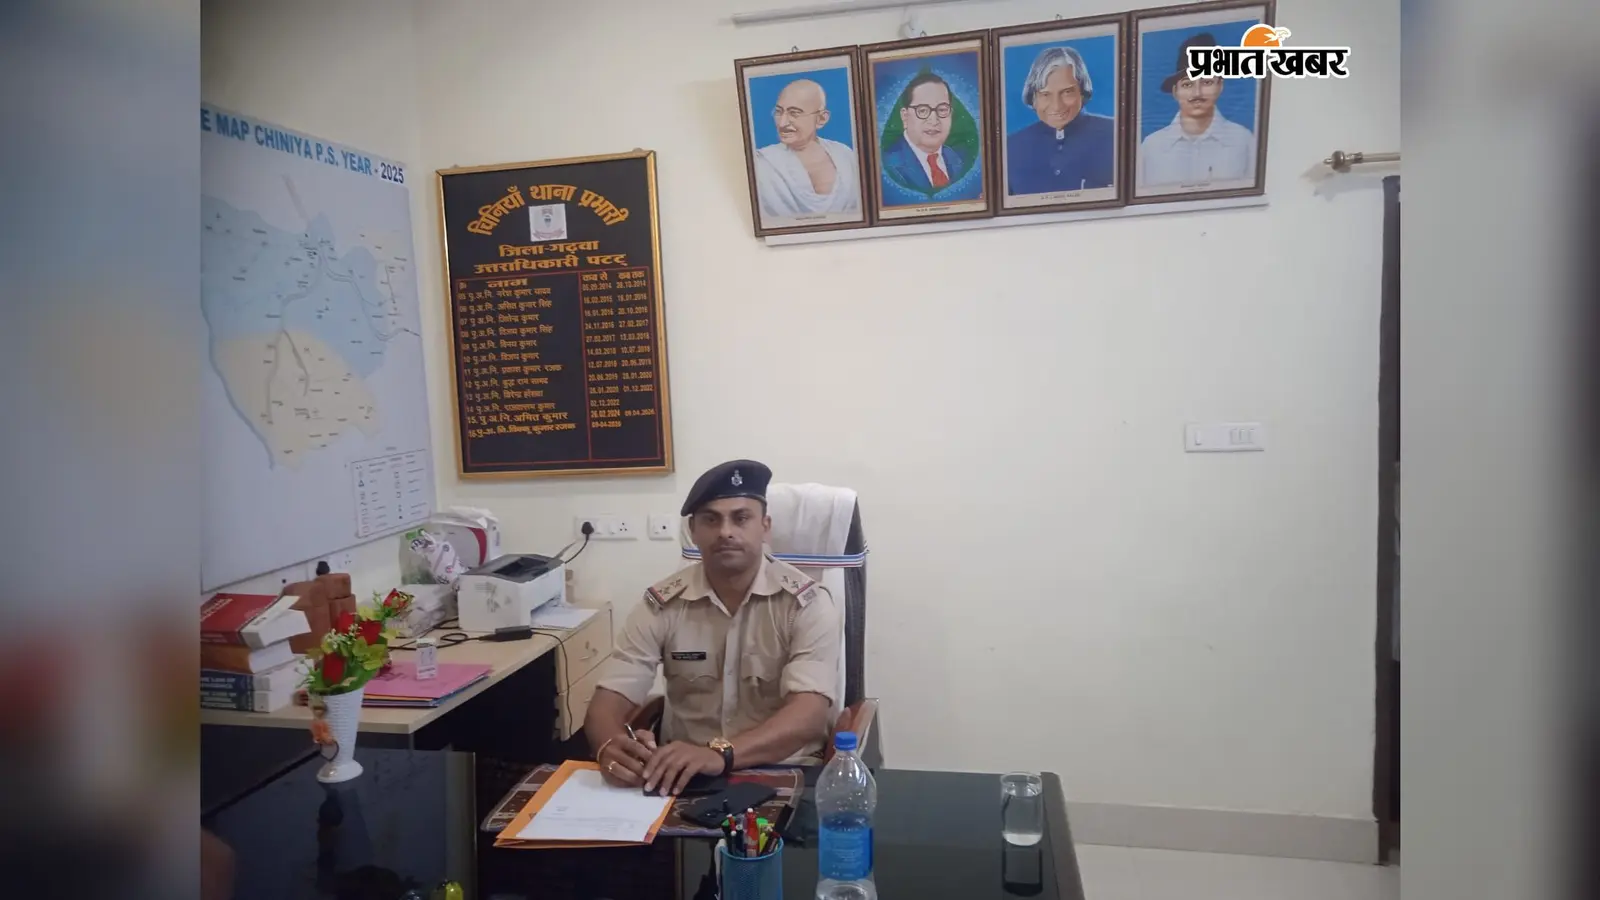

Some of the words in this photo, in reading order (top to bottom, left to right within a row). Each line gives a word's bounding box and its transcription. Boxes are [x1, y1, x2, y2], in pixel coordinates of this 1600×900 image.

[216, 113, 250, 141] MAP
[254, 125, 313, 159] CHINIYA
[316, 143, 339, 167] P.S.
[341, 150, 372, 176] YEAR
[380, 162, 405, 184] 2025
[529, 184, 577, 201] थाना
[578, 189, 629, 226] प्रभारी
[473, 255, 579, 274] उत्तराधिकारी
[513, 412, 540, 422] अमित
[542, 412, 569, 423] कुमार
